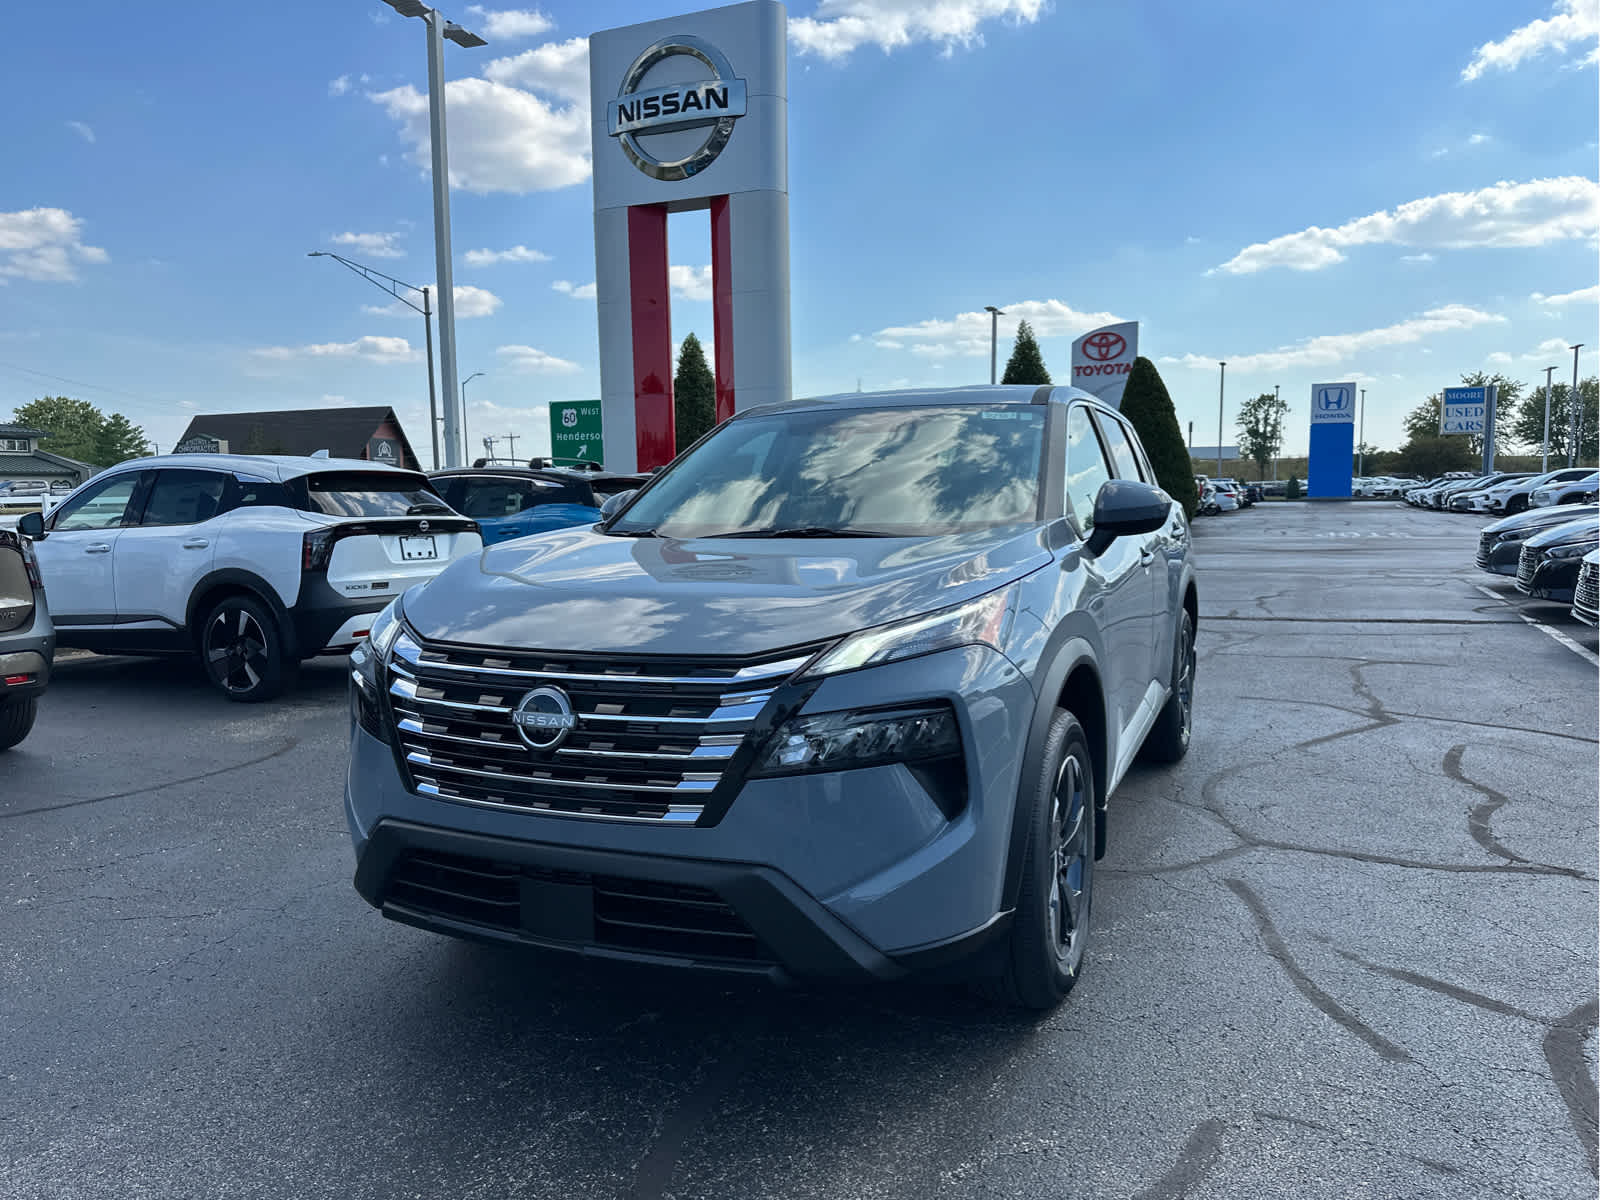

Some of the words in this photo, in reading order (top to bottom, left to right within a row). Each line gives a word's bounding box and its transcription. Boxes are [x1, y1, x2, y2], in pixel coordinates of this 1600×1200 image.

[618, 87, 729, 125] NISSAN
[1074, 362, 1132, 377] TOYOTA
[1447, 391, 1483, 400] MOORE
[1445, 407, 1485, 417] USED
[564, 412, 576, 424] 60
[1444, 420, 1484, 431] CARS
[556, 432, 604, 441] Henderso
[513, 713, 574, 727] NISSAN
